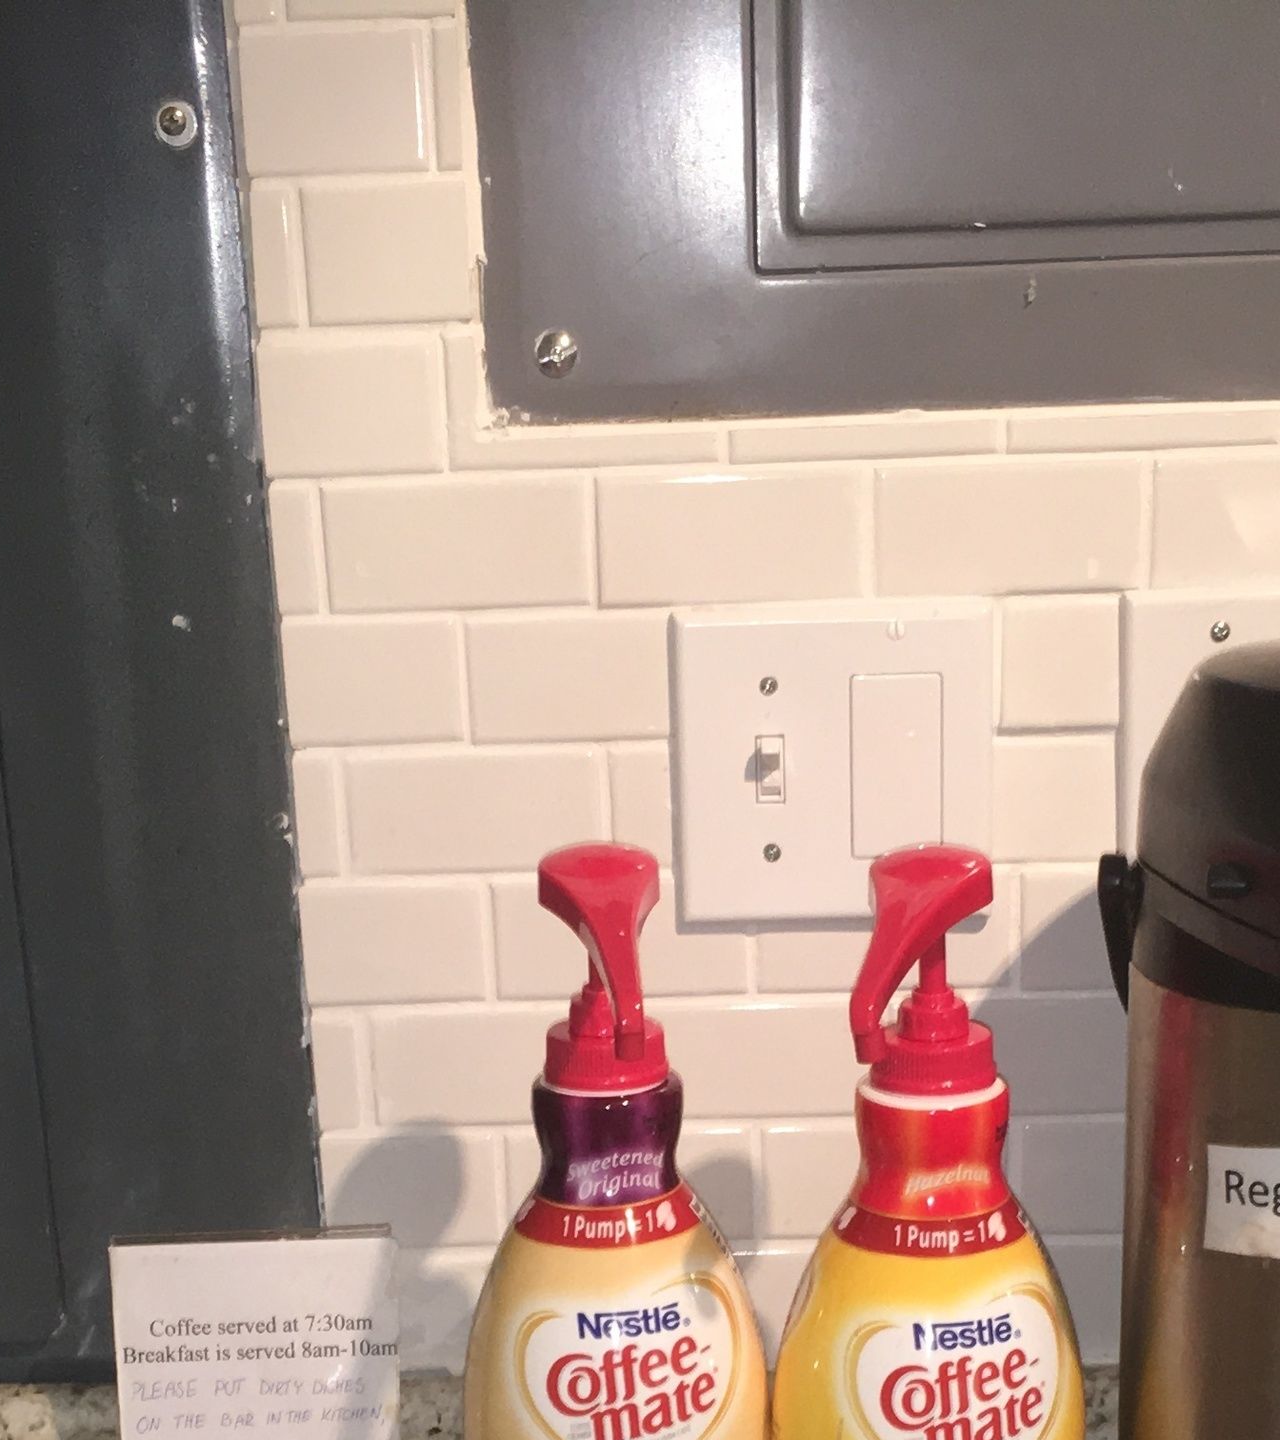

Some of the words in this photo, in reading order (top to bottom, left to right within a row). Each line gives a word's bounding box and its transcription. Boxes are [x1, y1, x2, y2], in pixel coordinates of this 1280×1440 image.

[567, 1151, 664, 1182] Sweetened
[578, 1170, 661, 1201] Original
[563, 1216, 571, 1238] 1
[575, 1215, 626, 1244] Pump
[894, 1224, 901, 1246] 1
[907, 1225, 960, 1253] Pump
[150, 1318, 211, 1338] Coffee
[218, 1316, 276, 1336] served
[282, 1317, 299, 1333] at
[305, 1314, 372, 1332] 7:30am
[123, 1344, 210, 1364] Breakfast
[216, 1344, 231, 1362] is
[237, 1341, 295, 1361] served
[302, 1339, 399, 1359] 8am-10am
[133, 1380, 197, 1401] PLEASE
[214, 1378, 246, 1397] PUT
[136, 1416, 161, 1434] ON
[174, 1413, 205, 1430] THE
[221, 1412, 254, 1428] BAR
[266, 1408, 282, 1425] IN
[286, 1406, 311, 1423] THE
